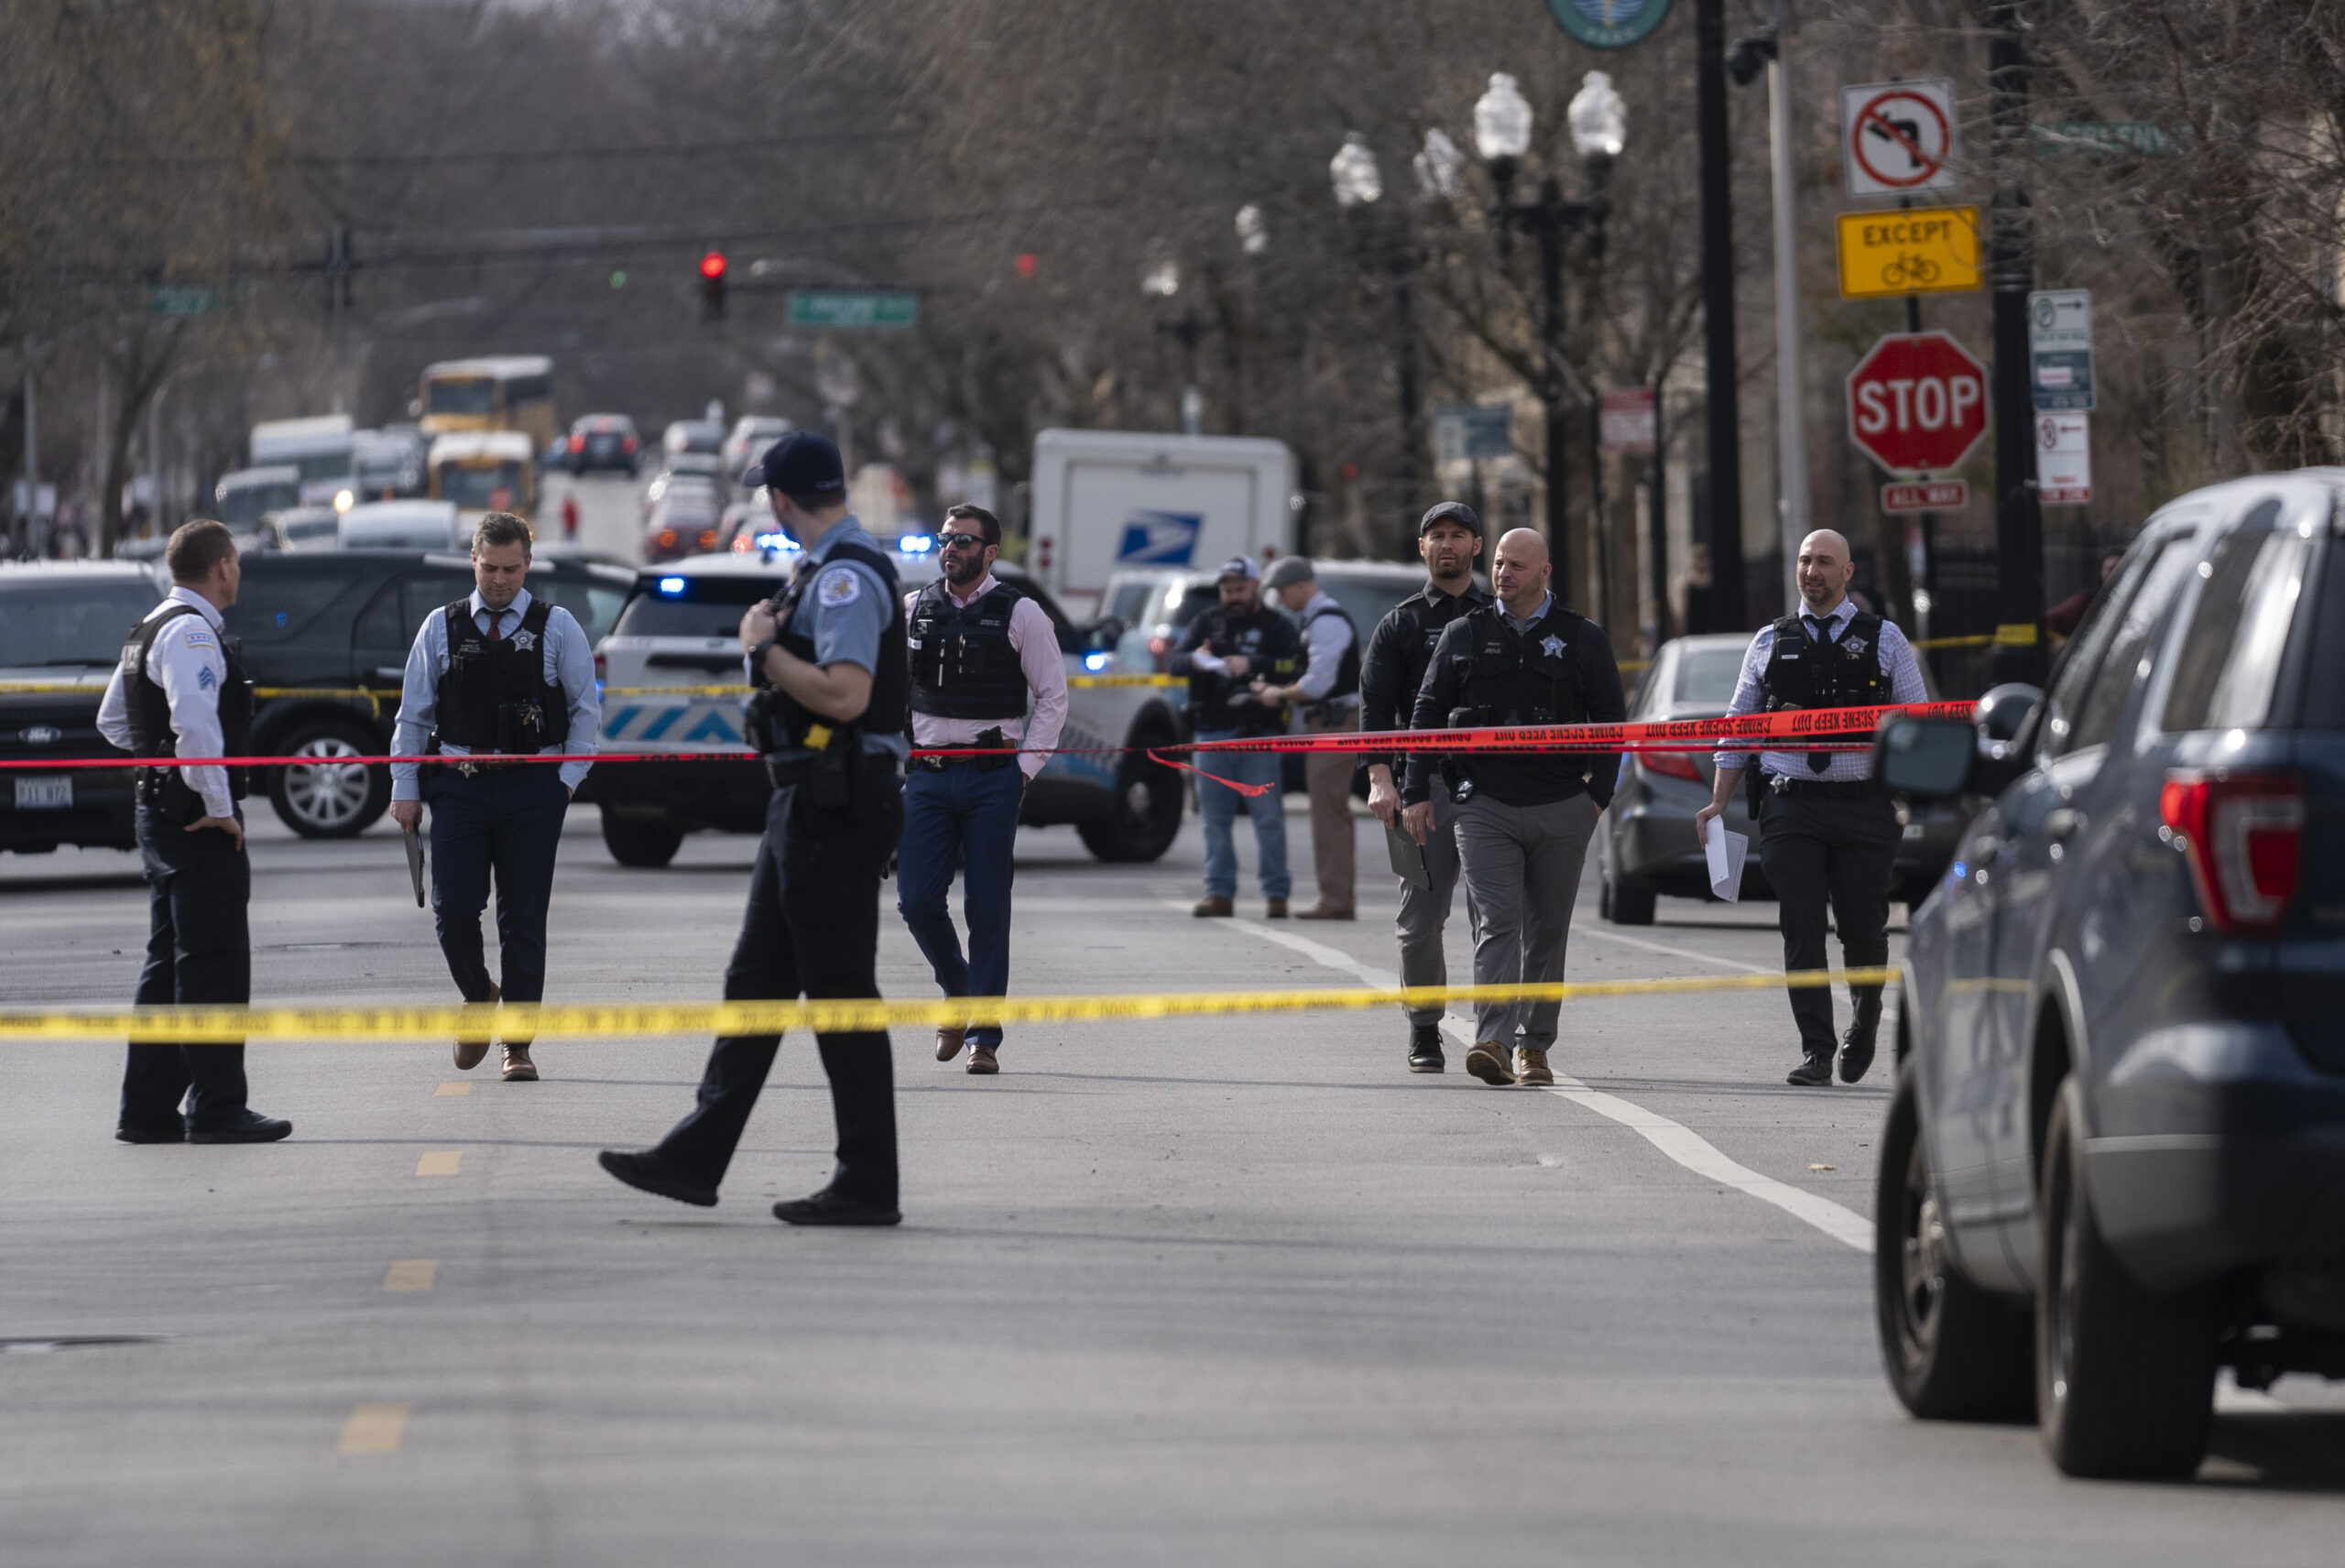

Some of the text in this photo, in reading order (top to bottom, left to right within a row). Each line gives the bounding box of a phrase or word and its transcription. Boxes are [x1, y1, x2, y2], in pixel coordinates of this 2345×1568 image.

[1863, 220, 1950, 247] EXCEPT
[1858, 375, 1980, 434] STOP
[1892, 487, 1959, 506] ALL WAY
[1645, 716, 1772, 737] CRIME SCENE KEEP OUT
[1792, 714, 1812, 733] OUT
[1815, 713, 1839, 731] KEEP
[1843, 710, 1874, 729] SCENE
[1550, 727, 1585, 740] SCENE
[1587, 725, 1623, 739] CRIME
